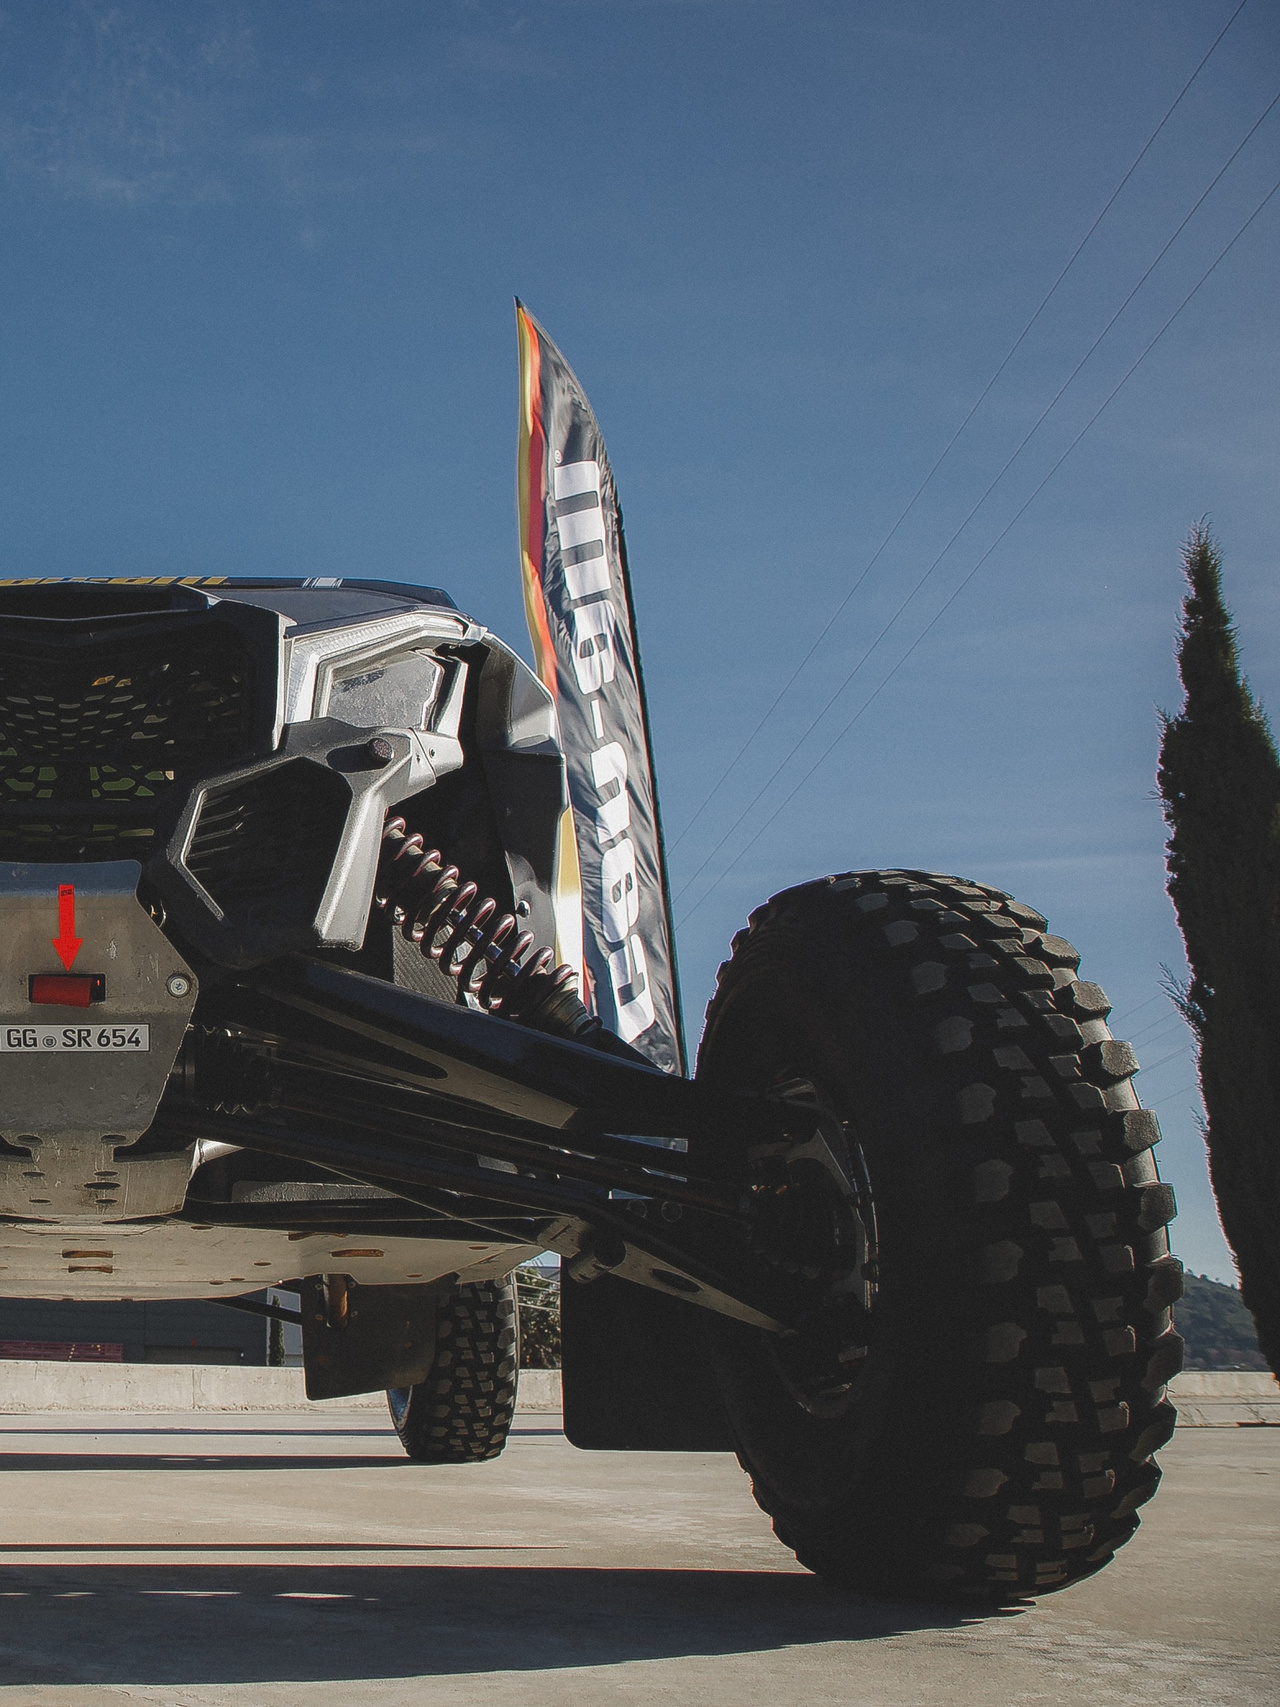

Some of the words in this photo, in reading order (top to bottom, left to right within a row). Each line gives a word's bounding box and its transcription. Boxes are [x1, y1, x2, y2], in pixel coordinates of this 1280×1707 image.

[6, 1028, 38, 1048] GG
[62, 1028, 93, 1048] SR
[97, 1028, 141, 1048] 654
